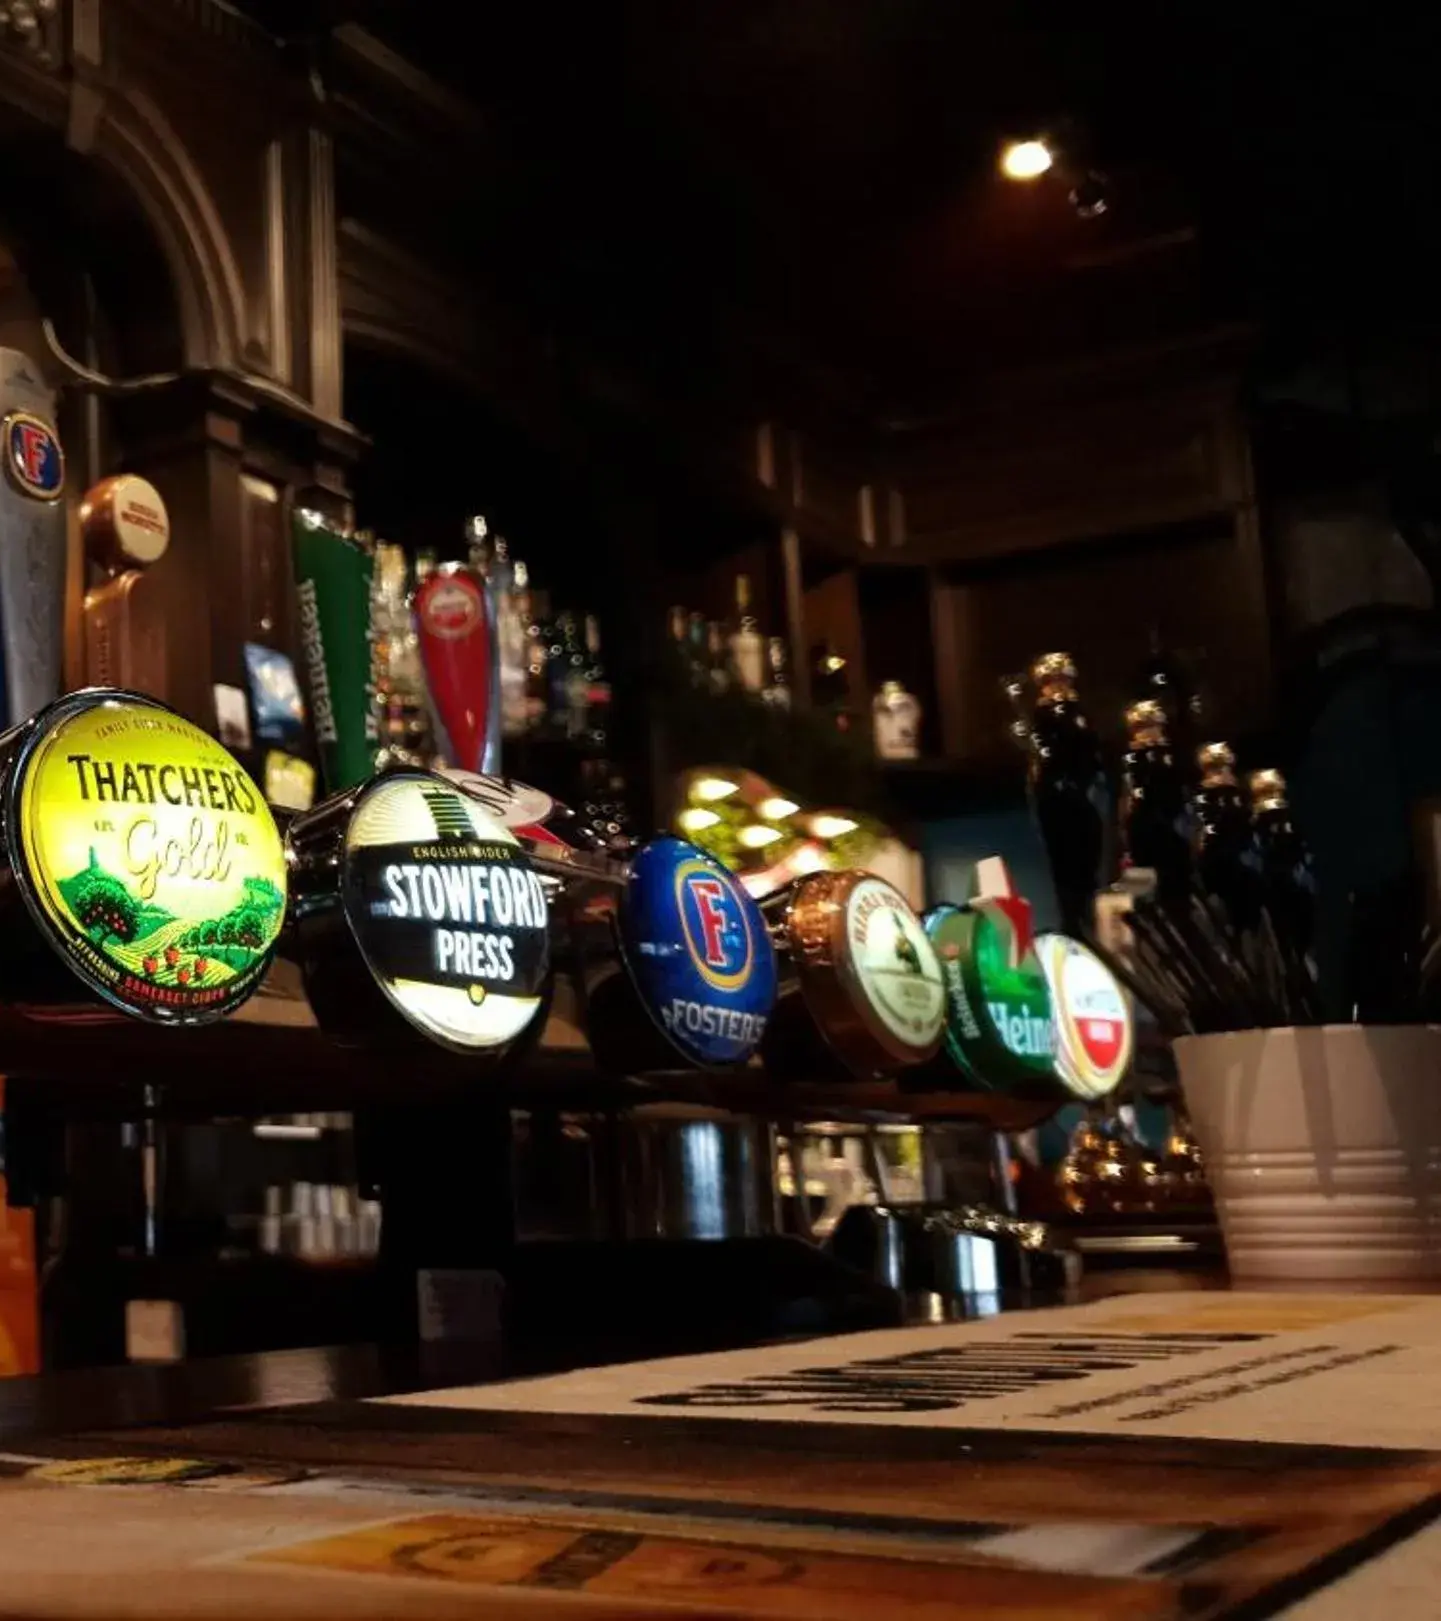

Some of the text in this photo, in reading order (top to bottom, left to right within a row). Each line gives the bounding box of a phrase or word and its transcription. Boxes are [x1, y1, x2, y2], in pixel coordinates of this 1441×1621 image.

[67, 754, 257, 815] THATCHERS
[126, 816, 232, 900] Gold
[412, 846, 468, 860] ENGLISH
[386, 864, 548, 928] STOWFORD
[688, 879, 728, 967] F
[437, 929, 515, 981] PRESS
